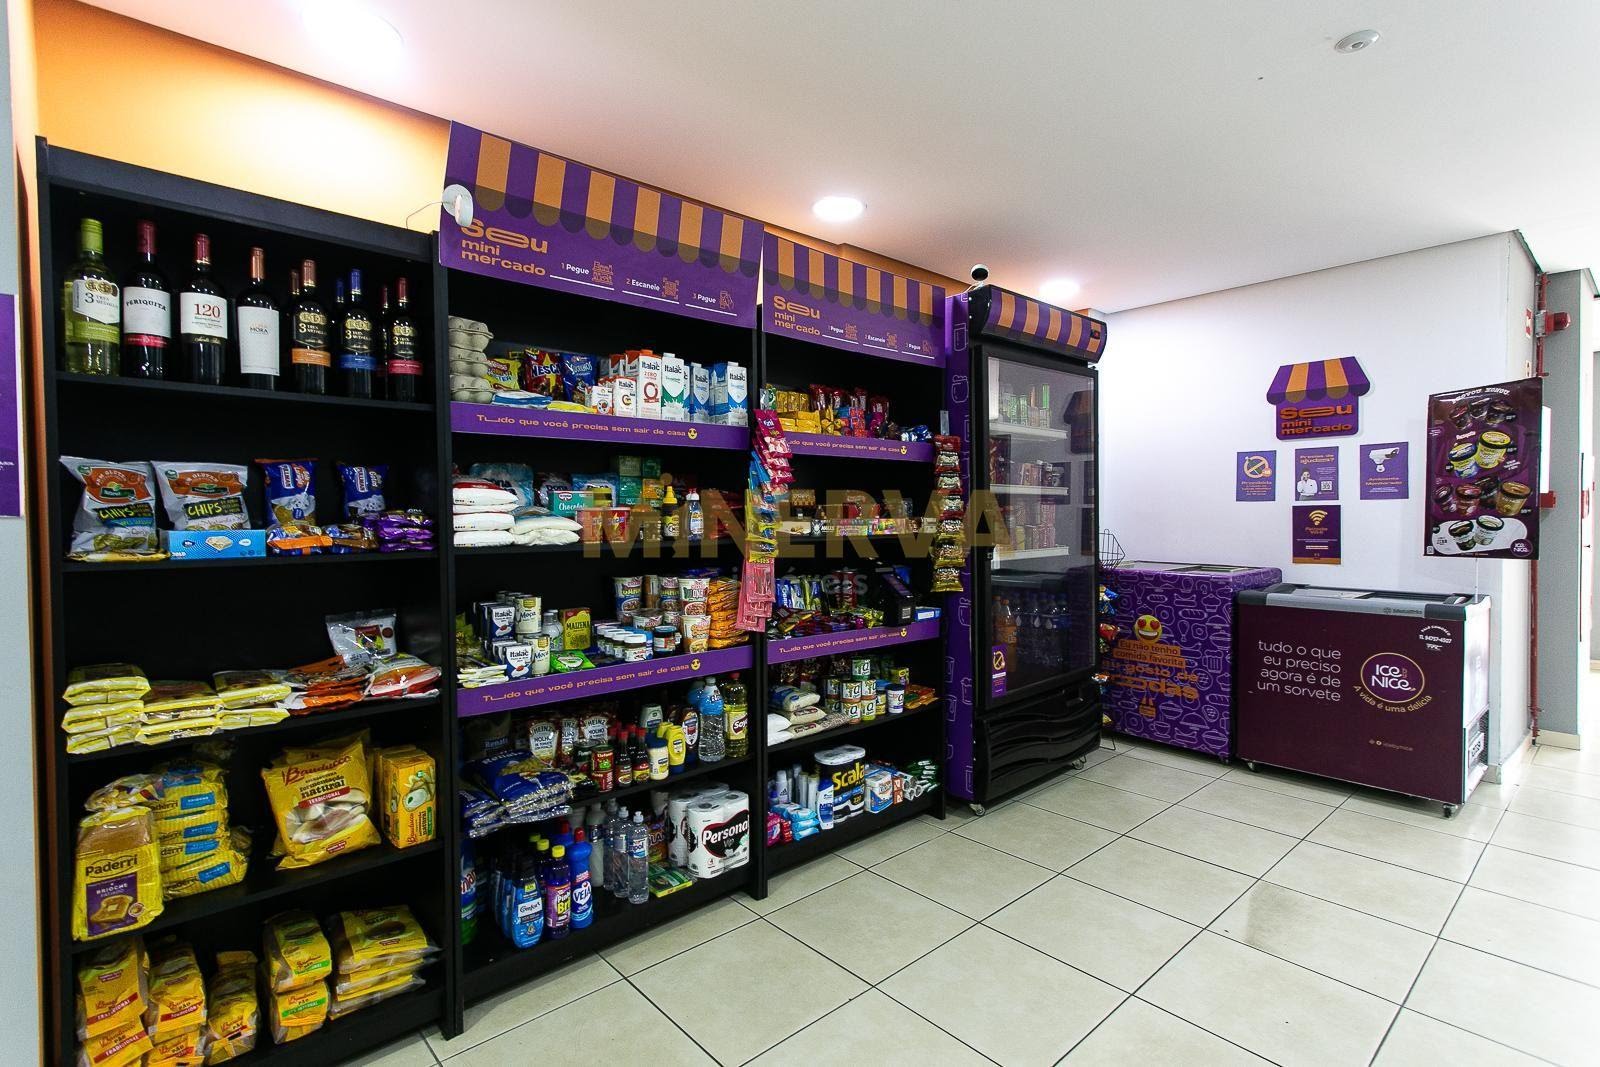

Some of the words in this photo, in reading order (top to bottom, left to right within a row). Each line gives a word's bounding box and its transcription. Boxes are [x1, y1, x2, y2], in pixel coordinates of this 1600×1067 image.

[462, 239, 500, 255] mini
[461, 250, 546, 276] mercado
[566, 264, 590, 276] Pegue
[84, 292, 94, 304] 3
[126, 299, 167, 311] PERIQUITA
[697, 294, 716, 304] Pague
[194, 303, 221, 318] 120
[773, 295, 820, 320] Seu
[774, 311, 796, 322] mini
[298, 323, 306, 334] 3
[774, 319, 821, 336] mercado
[345, 330, 352, 340] 3
[392, 336, 399, 346] 3
[641, 361, 660, 371] Italac
[664, 364, 682, 374] Italac
[729, 372, 746, 381] Italac
[1280, 404, 1353, 420] Seu
[519, 419, 539, 428] que
[543, 420, 569, 429] você
[572, 422, 609, 433] precisa
[1281, 418, 1312, 428] mini
[1281, 423, 1352, 435] mercado
[99, 507, 135, 520] CHIPS
[187, 502, 222, 516] CHIPS
[494, 609, 513, 618] Italac
[520, 610, 536, 619] Moça
[815, 641, 832, 649] você
[1133, 641, 1149, 651] não
[1151, 645, 1178, 655] tenho
[1257, 639, 1292, 654] tudo
[1296, 646, 1306, 655] o
[1310, 647, 1341, 660] que
[510, 649, 529, 658] Italac
[1116, 650, 1147, 660] comida
[1149, 655, 1183, 666] favorita
[1126, 664, 1171, 677] gosto
[1262, 655, 1281, 665] eu
[1285, 657, 1340, 674] preciso
[1375, 663, 1402, 677] ICE
[525, 687, 545, 696] que
[548, 682, 573, 692] você
[576, 676, 613, 688] precisa
[616, 673, 635, 681] sem
[638, 669, 653, 678] sair
[656, 666, 668, 674] de
[670, 664, 689, 672] casa
[1260, 667, 1302, 682] agora
[1305, 672, 1315, 684] é
[1319, 674, 1340, 688] de
[1371, 675, 1412, 691] NICE
[1256, 680, 1279, 693] um
[1283, 684, 1340, 702] sorvete
[1352, 684, 1360, 692] A
[1358, 691, 1375, 706] vida
[1384, 704, 1406, 713] uma
[1406, 694, 1432, 712] delícia
[587, 718, 606, 726] HEINZ
[533, 725, 552, 734] HEINZ
[282, 755, 351, 786] Bauducco
[831, 762, 865, 790] Scala
[299, 775, 344, 792] fermentação
[301, 781, 345, 798] natural
[86, 854, 138, 876] Paderri
[96, 883, 128, 894] BRIOCHE
